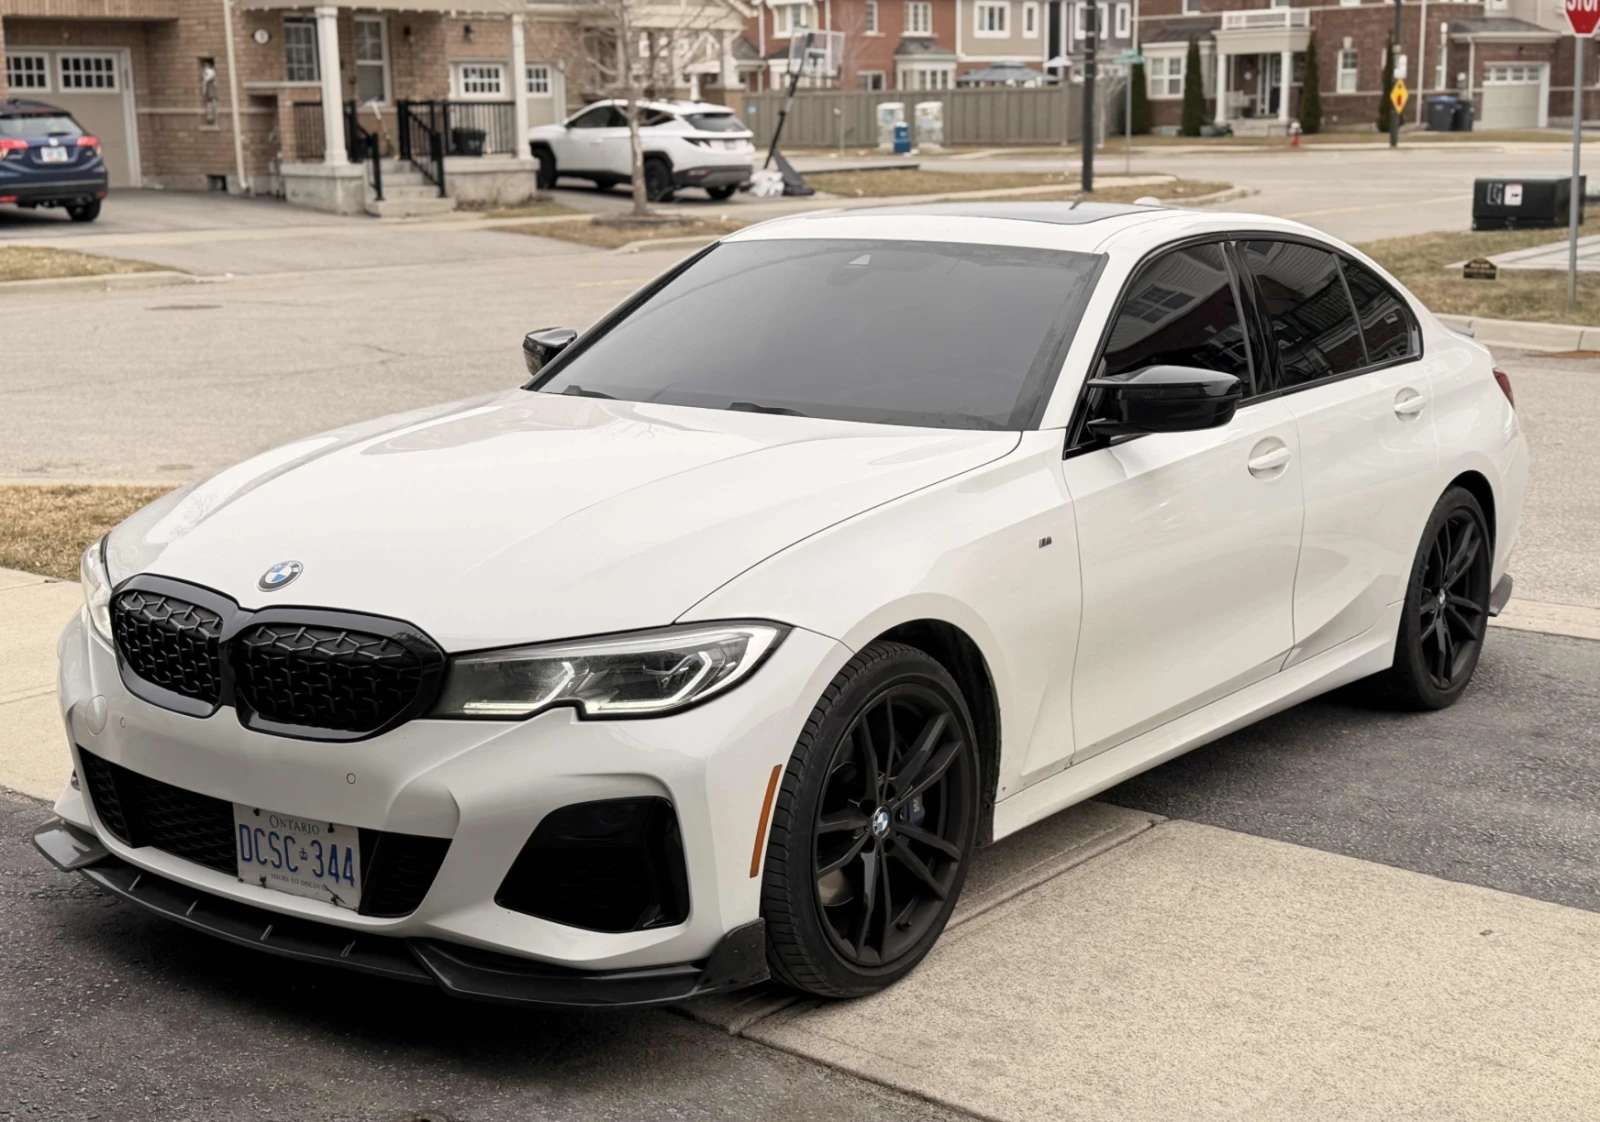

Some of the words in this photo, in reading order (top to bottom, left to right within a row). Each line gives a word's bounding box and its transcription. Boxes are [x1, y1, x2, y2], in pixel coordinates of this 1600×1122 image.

[269, 814, 320, 835] ONTARIO
[238, 823, 299, 873] DCSC
[310, 840, 355, 887] 344
